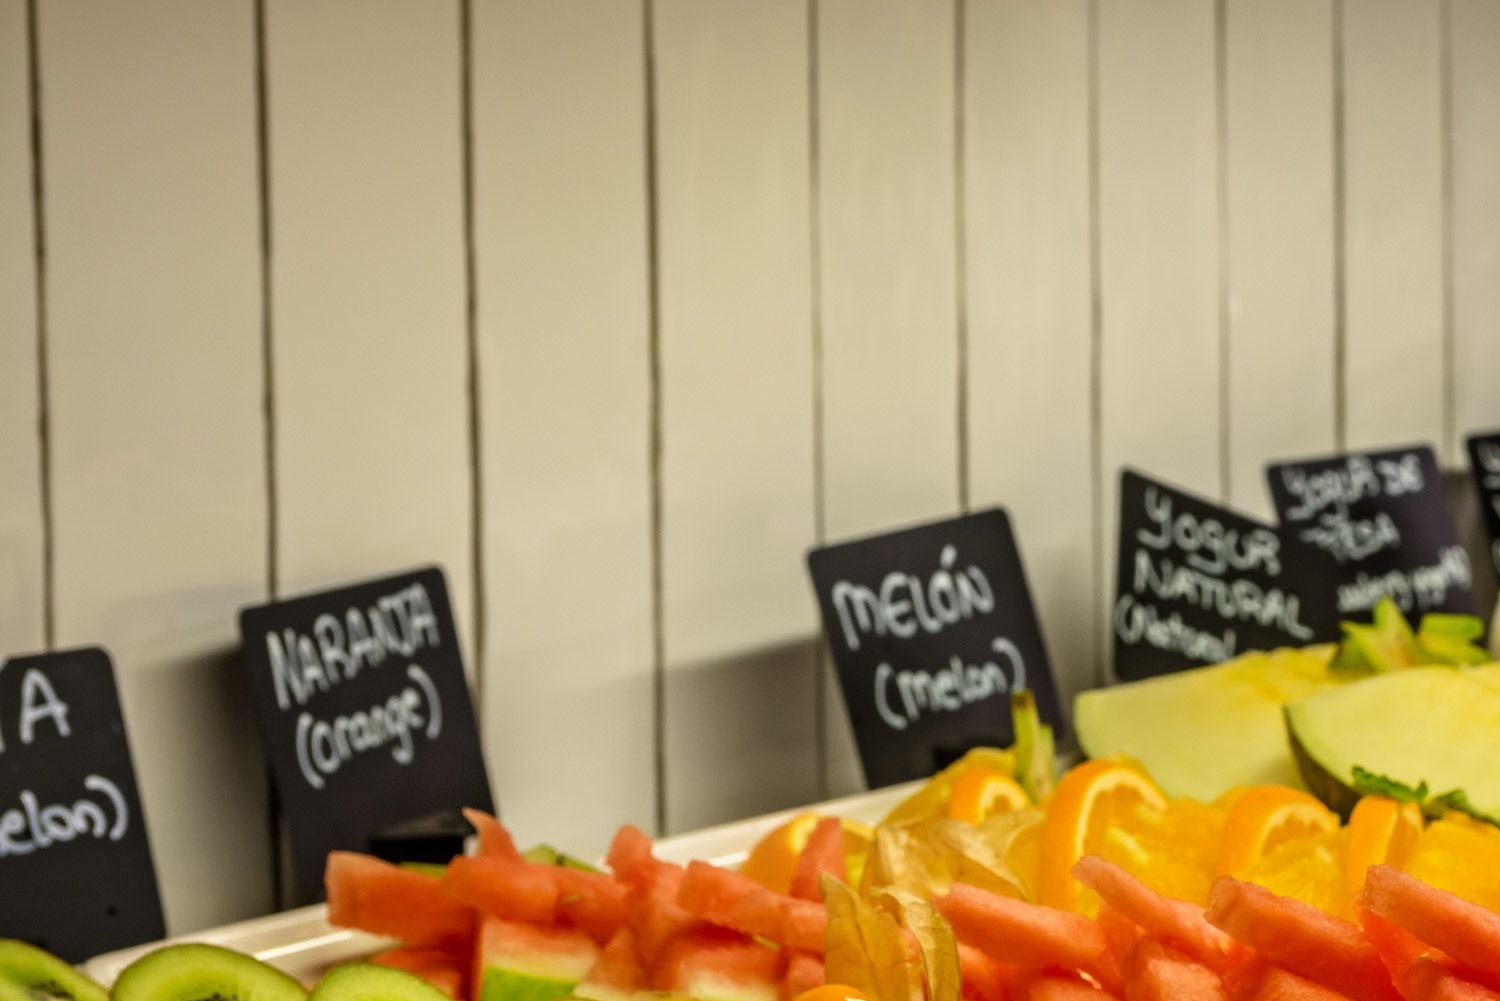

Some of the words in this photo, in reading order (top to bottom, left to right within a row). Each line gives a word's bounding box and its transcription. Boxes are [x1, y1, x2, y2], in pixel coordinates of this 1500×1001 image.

[1136, 487, 1281, 576] YOGUR
[831, 545, 995, 651] MELÓN
[1134, 548, 1314, 640] NATURAL
[266, 582, 440, 710] NARANJA
[875, 637, 1026, 731] (melon)
[0, 668, 71, 750] A
[296, 665, 441, 789] (orange)
